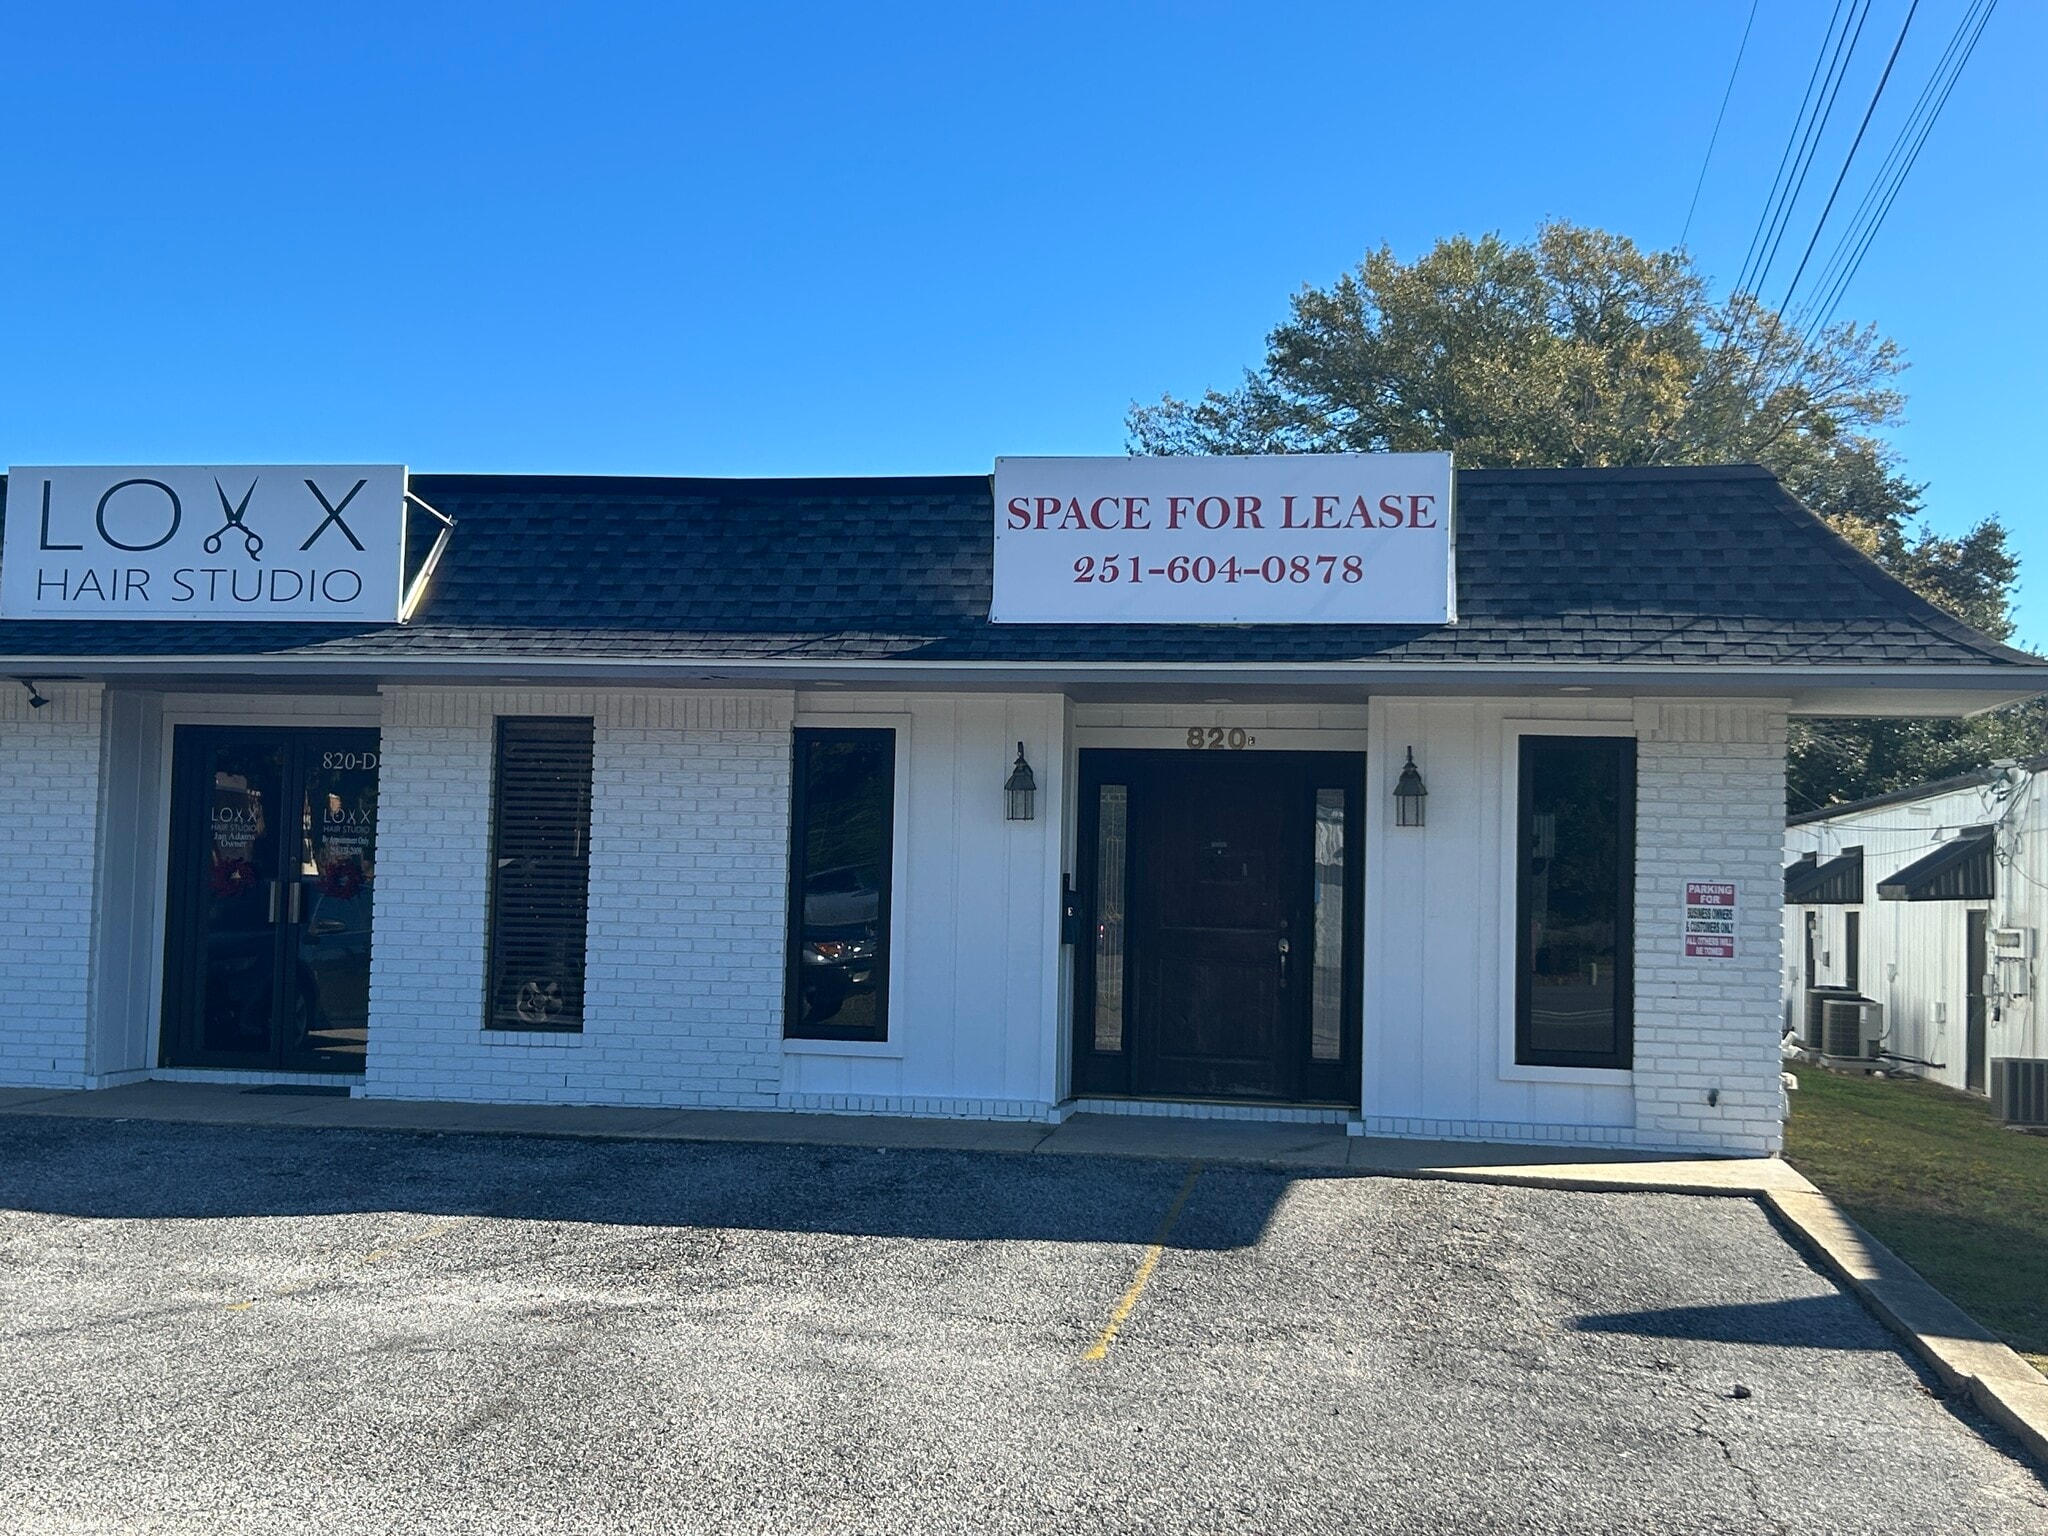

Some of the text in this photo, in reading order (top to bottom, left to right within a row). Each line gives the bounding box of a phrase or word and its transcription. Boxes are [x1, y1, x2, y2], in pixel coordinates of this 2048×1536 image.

[1007, 494, 1438, 531] SPACE FOR LEASE
[1073, 554, 1364, 584] 251-604-0878
[37, 568, 364, 604] HAIR STUDIO
[1187, 727, 1246, 750] 820
[323, 752, 377, 770] 820-D
[211, 824, 257, 833] HAIR STUDIO
[323, 825, 371, 834] HAIR STUDIO
[214, 832, 255, 840] Jan Adams
[221, 840, 248, 848] Owner
[1688, 884, 1733, 895] PARKING
[1700, 894, 1721, 904] FOR
